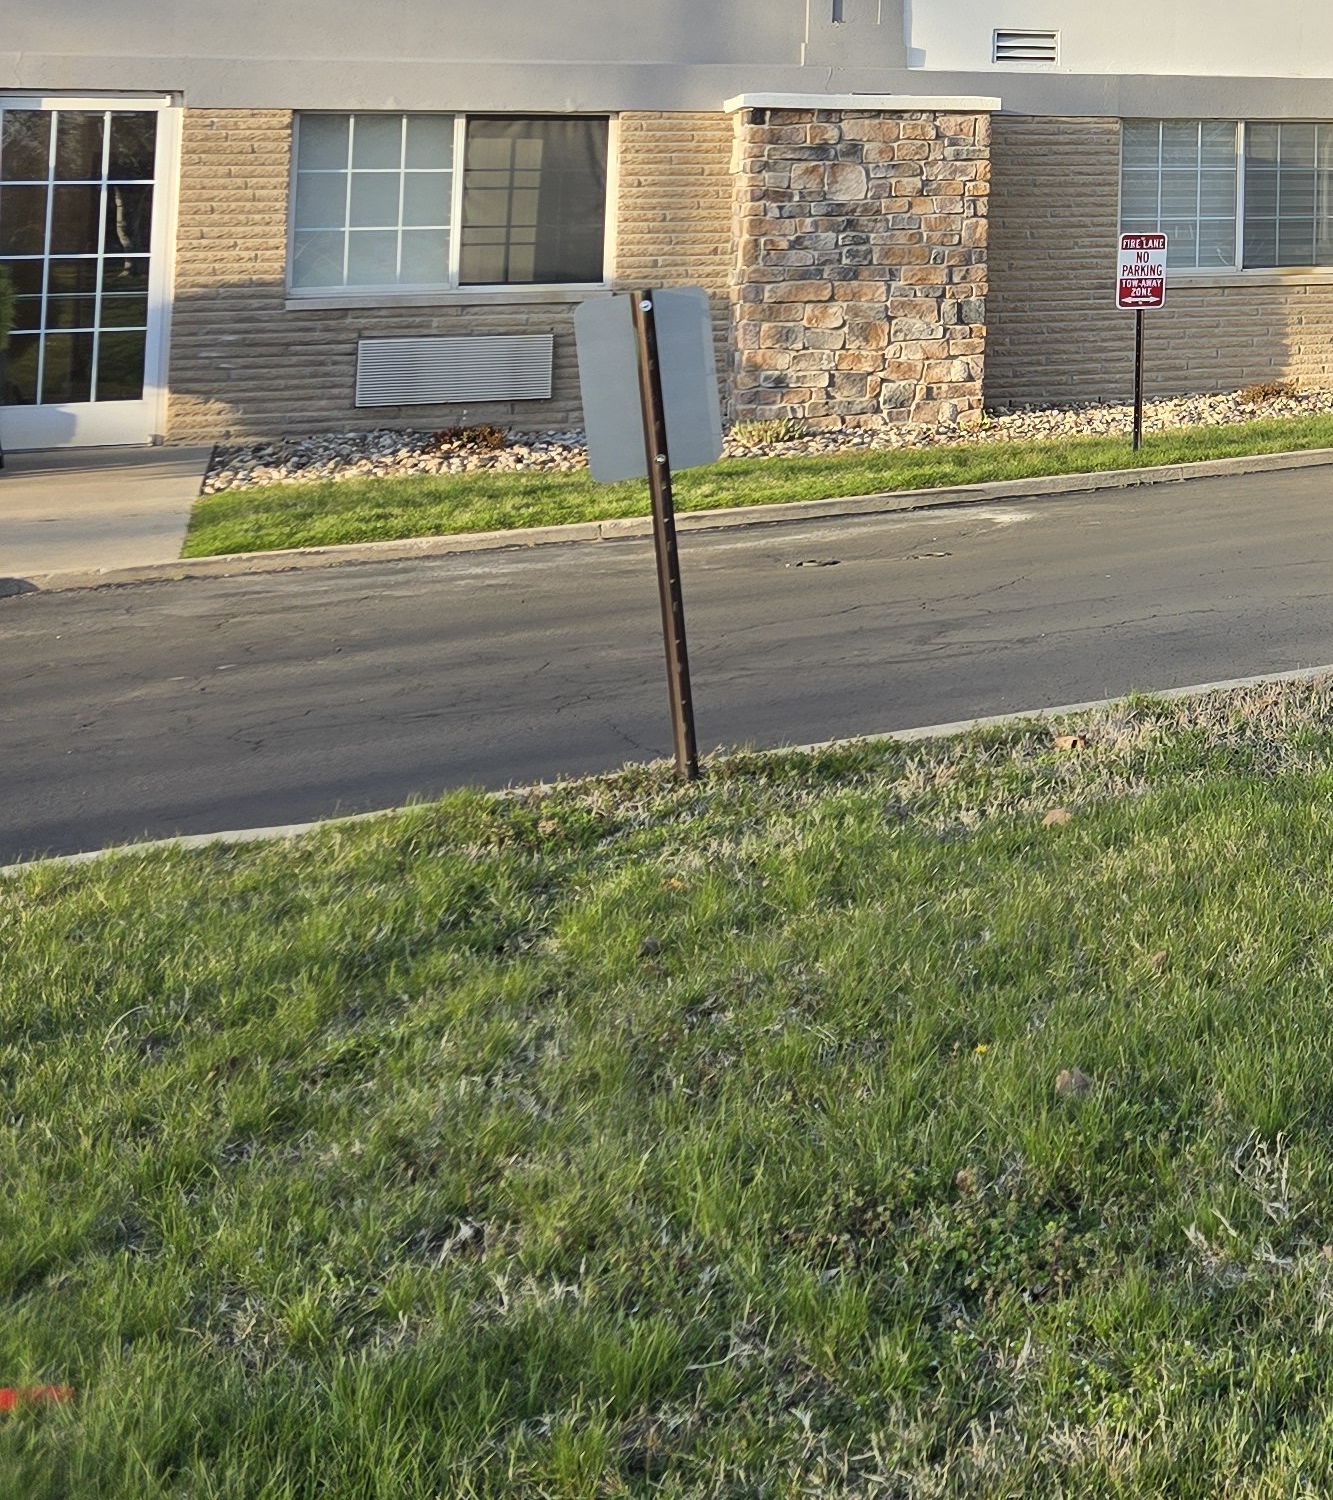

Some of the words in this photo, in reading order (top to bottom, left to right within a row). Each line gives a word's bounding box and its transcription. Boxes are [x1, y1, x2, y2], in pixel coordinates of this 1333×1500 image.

[1122, 239, 1140, 249] FIRE
[1143, 239, 1164, 249] LANE
[1136, 251, 1150, 263] NO
[1122, 264, 1163, 277] PARKING
[1121, 279, 1162, 288] TOW-AWAY
[1130, 288, 1152, 297] ZONE
